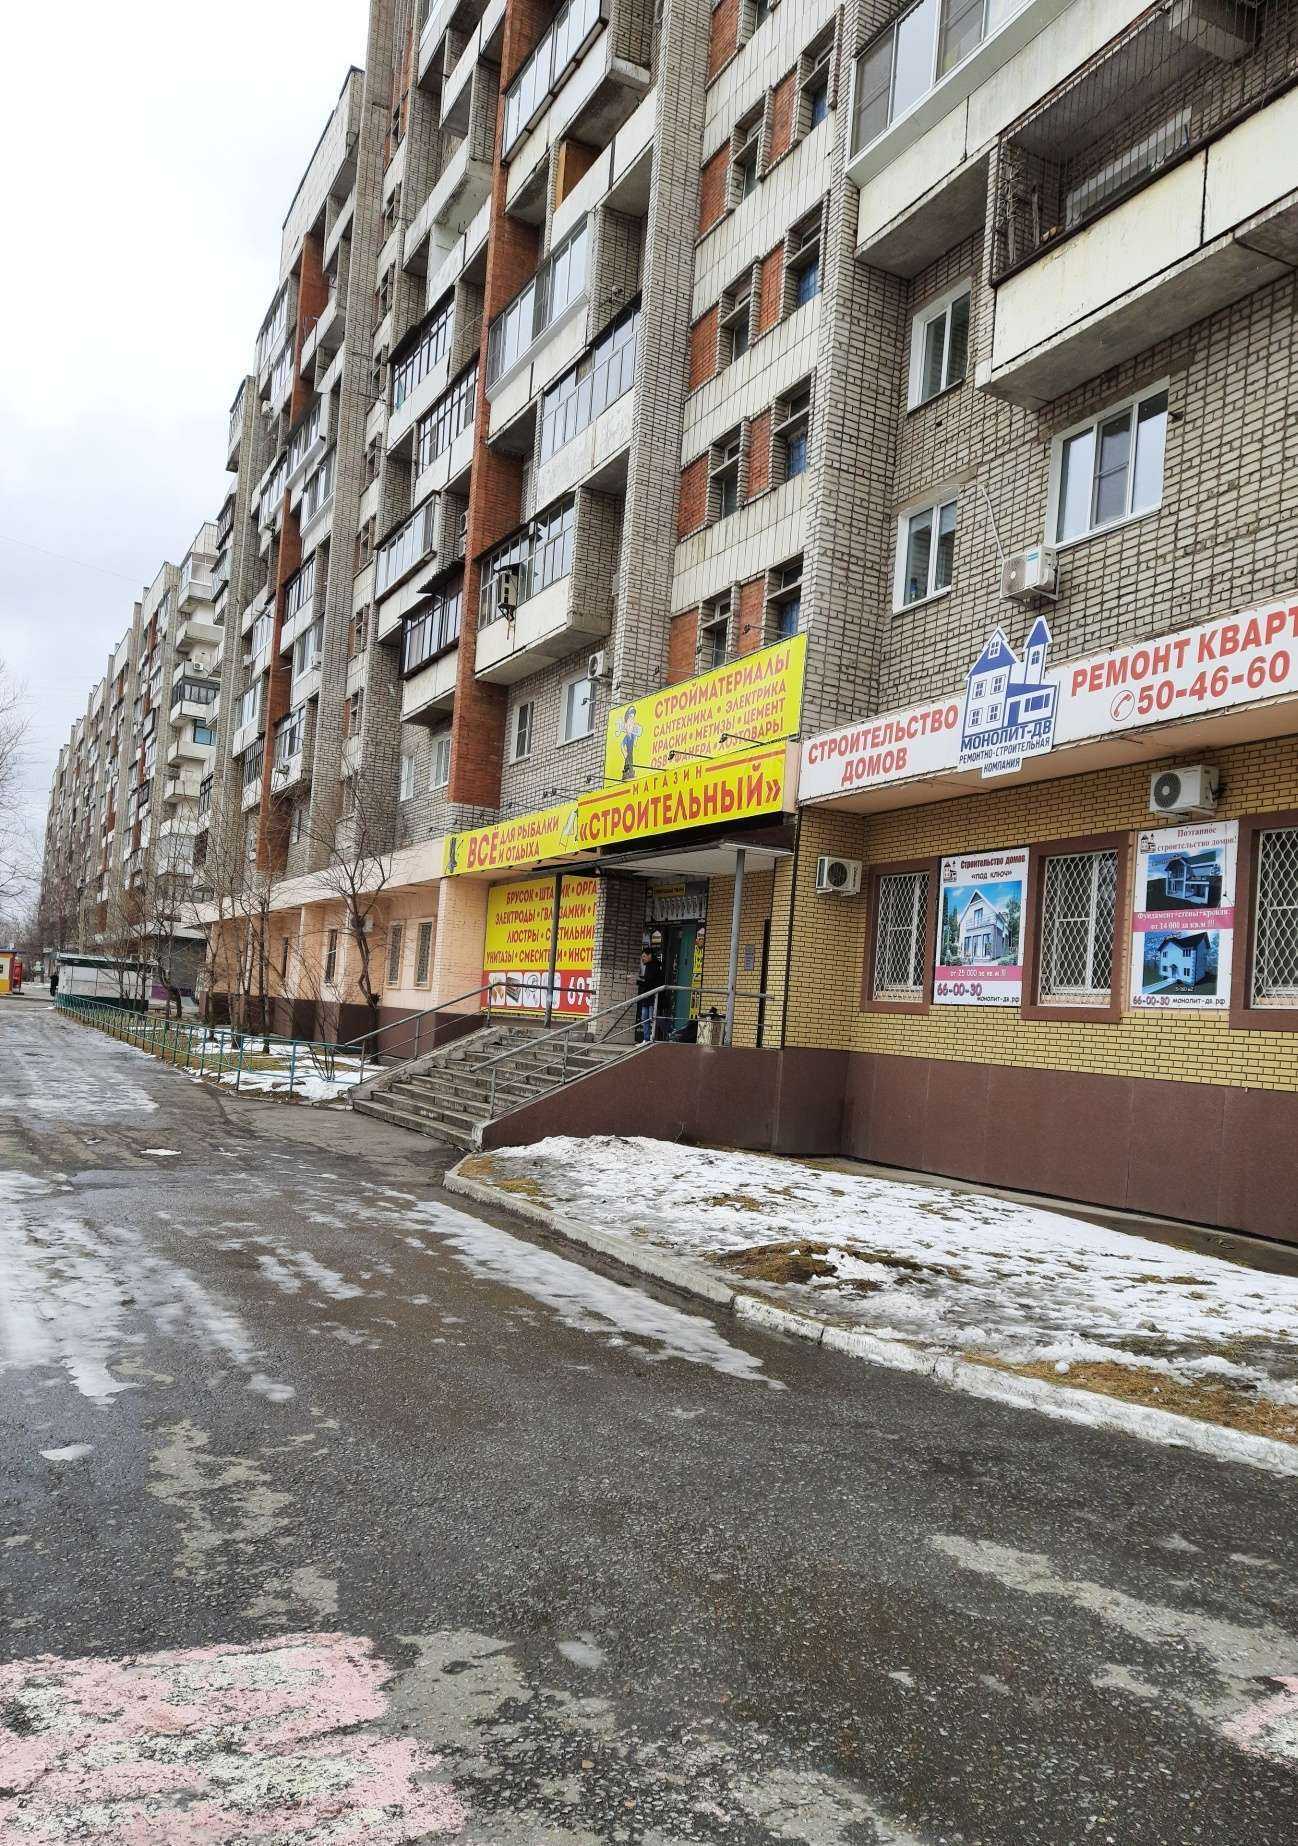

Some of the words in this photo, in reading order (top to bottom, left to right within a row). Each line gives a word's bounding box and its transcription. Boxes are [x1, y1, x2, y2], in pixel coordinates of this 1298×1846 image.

[1071, 637, 1191, 697] РЕМОНТ
[654, 649, 791, 720] СТРОЙМАТЕРИАЛЫ
[1137, 650, 1290, 715] 50-46-60
[653, 706, 713, 738] САНТЕХНИКА
[726, 678, 786, 713] ЭЛЕКТРИКА
[652, 731, 687, 755] КРАСКИ
[695, 717, 735, 742] МЕТИЗЫ
[743, 697, 785, 726] ЦЕМЕНТ
[808, 704, 959, 765] СТРОИТЕЛЬСТВО
[960, 719, 1053, 752] МОНОЛИТ-ДВ
[959, 737, 1051, 764] РЕМОНТНО-СТРОИТЕЛЬНАЯ
[841, 747, 908, 787] ДОМОВ
[983, 758, 1020, 774] КОМПАНИЯ
[580, 762, 781, 841] «СТРОИТЕЛЬНЫЙ»
[500, 826, 516, 845] ДЛЯ
[517, 815, 560, 838] РЫБАЛКИ
[1177, 826, 1217, 838] Поэтапное
[467, 825, 500, 869] ВСЁ
[498, 849, 504, 863] И
[505, 841, 540, 861] ОТДЫХА
[1157, 840, 1210, 853] строительство
[960, 857, 1004, 870] Строительство
[1004, 854, 1026, 866] домов
[506, 888, 534, 905] БРУСОК
[495, 908, 536, 926] ЭЛЕКТРОДЫ
[560, 903, 586, 920] ЗАМКИ
[506, 928, 540, 943] ЛЮСТРЫ
[486, 949, 515, 965] УНИТАЗЫ
[936, 982, 983, 997] 66-00-30
[1132, 995, 1171, 1006] 66-00-30
